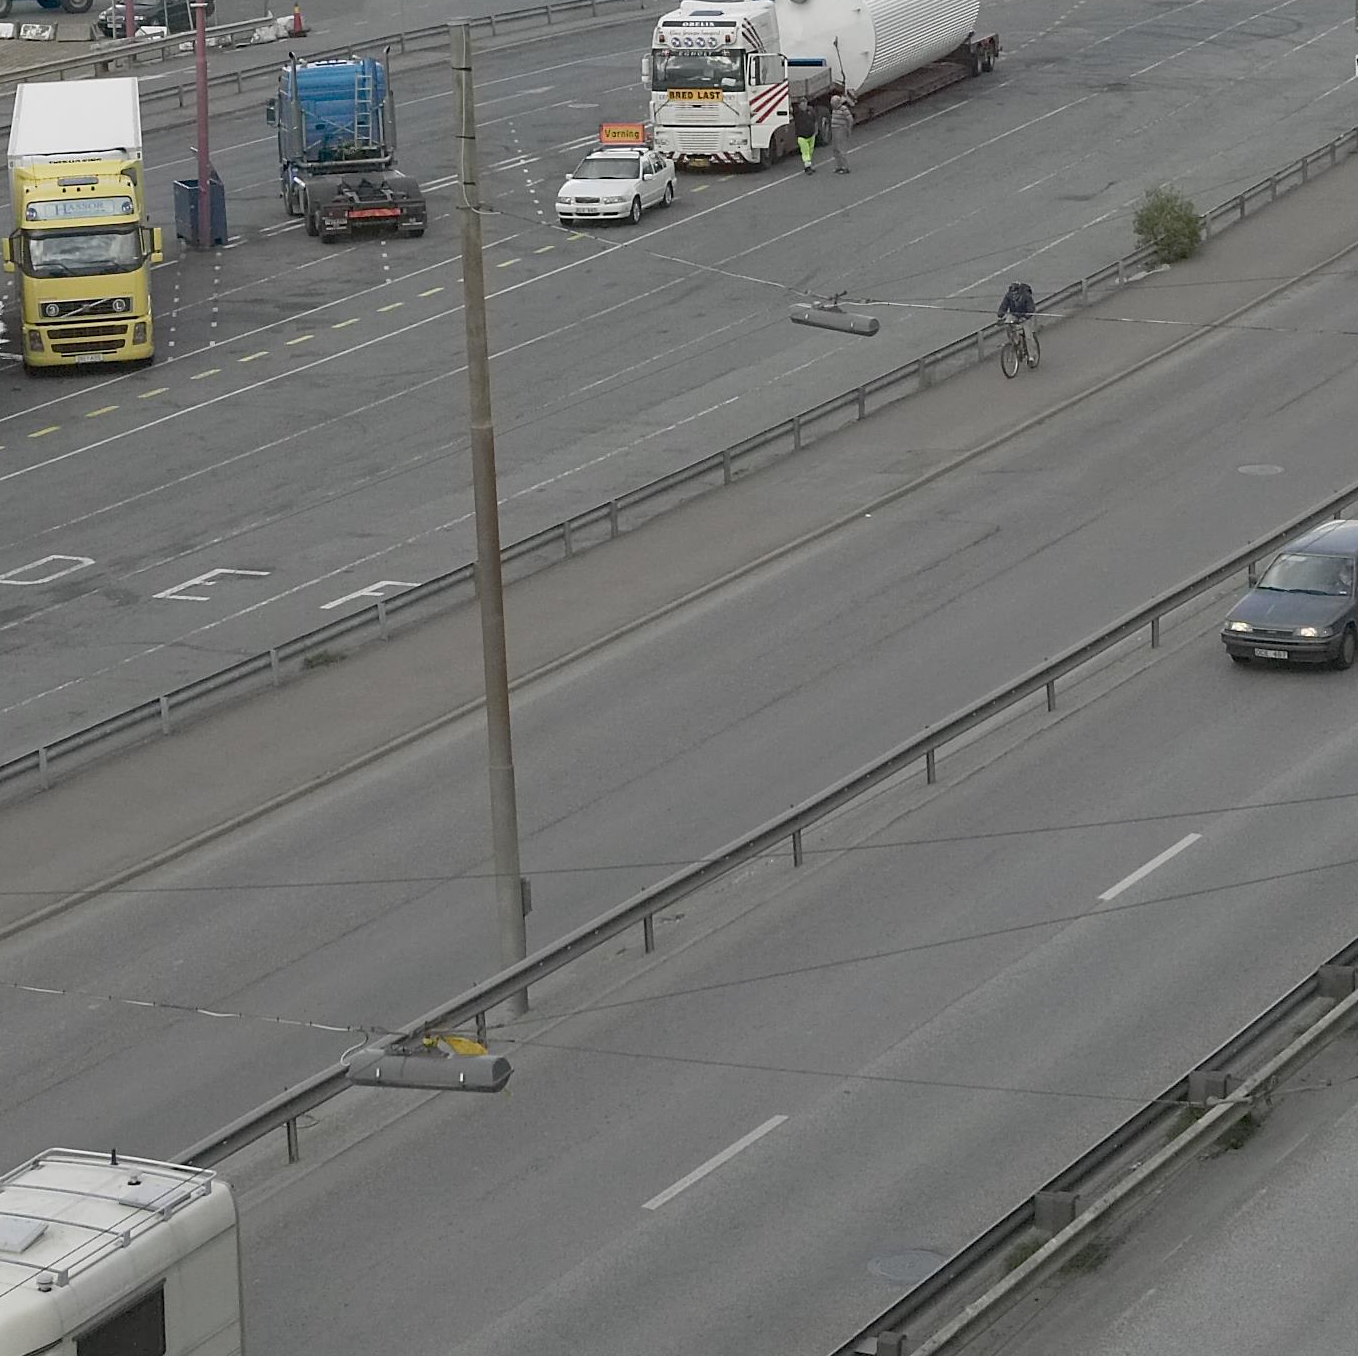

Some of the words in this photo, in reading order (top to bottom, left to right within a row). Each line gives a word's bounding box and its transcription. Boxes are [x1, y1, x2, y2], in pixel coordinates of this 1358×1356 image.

[669, 91, 694, 100] BRED
[697, 91, 721, 100] LAST
[604, 129, 640, 140] Varning
